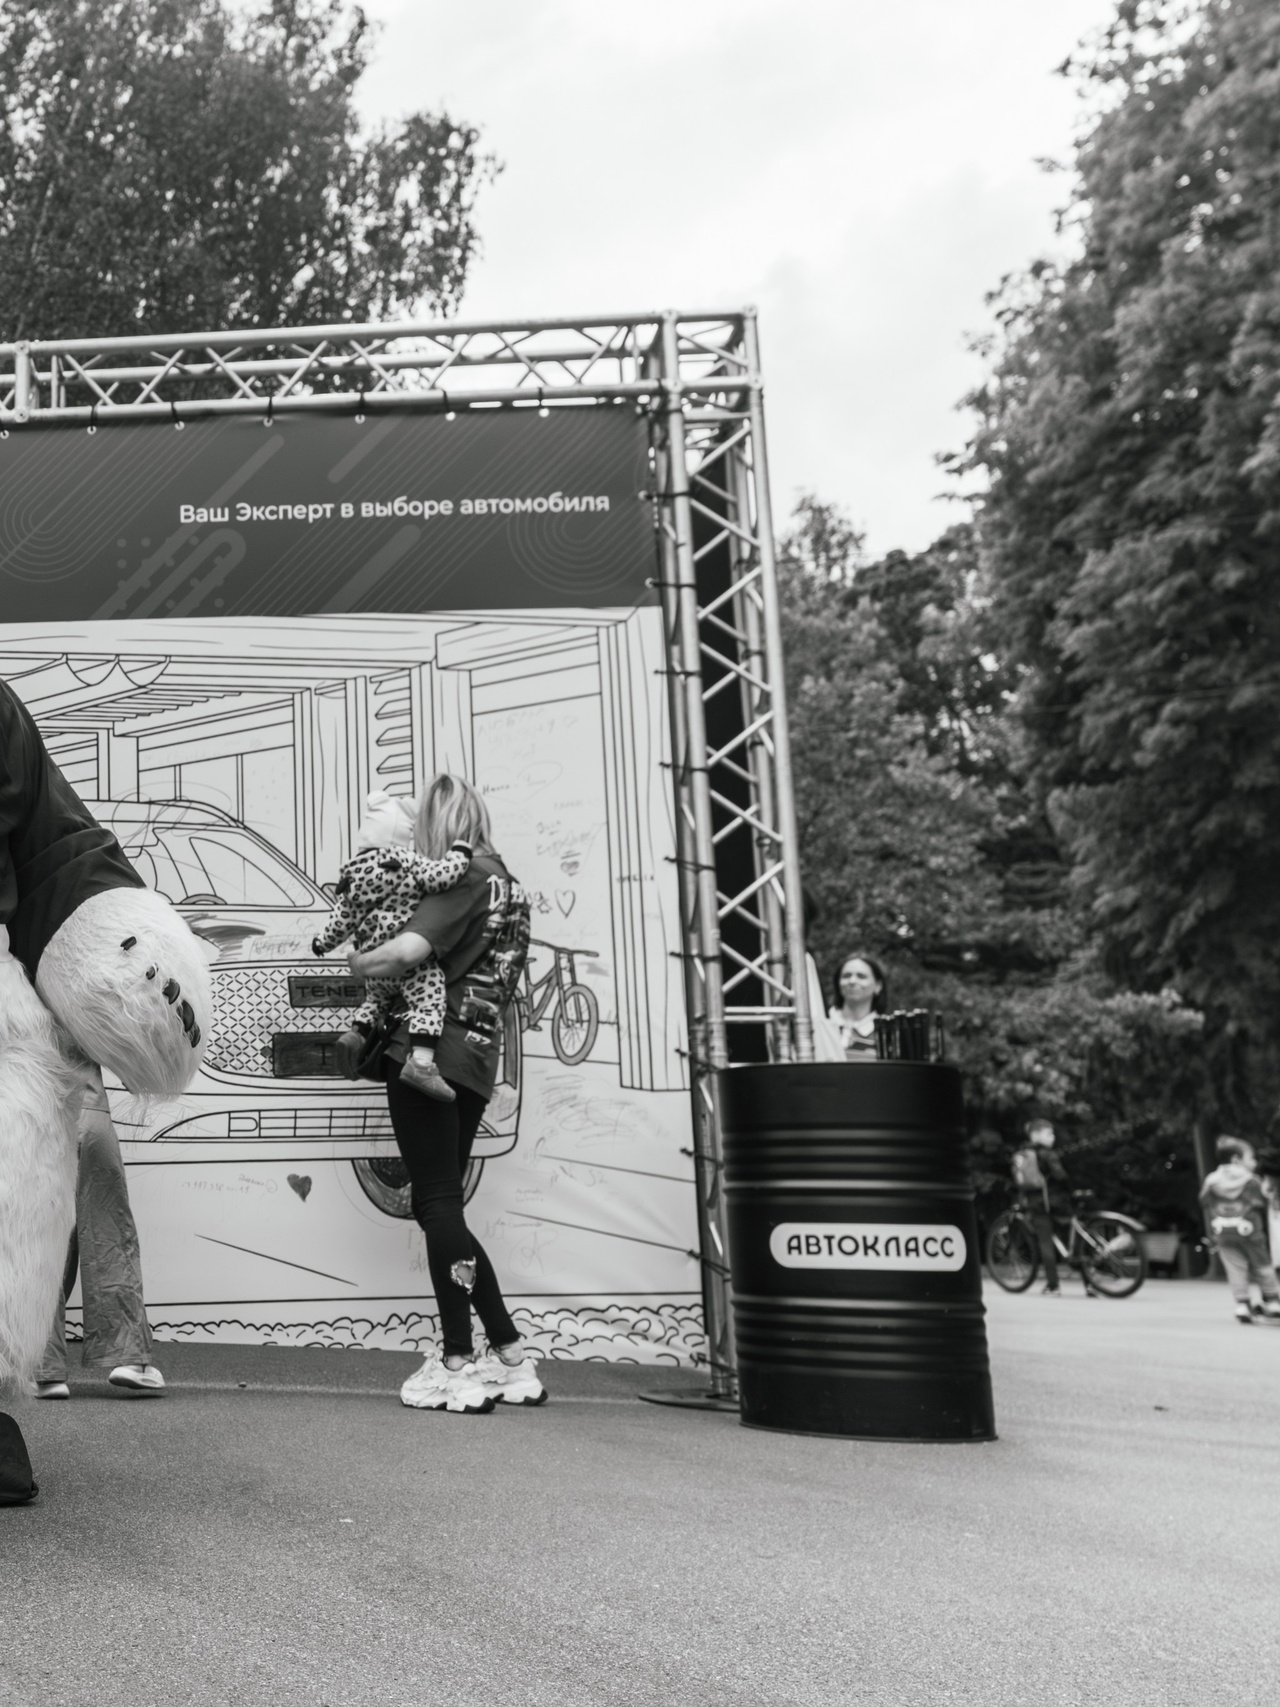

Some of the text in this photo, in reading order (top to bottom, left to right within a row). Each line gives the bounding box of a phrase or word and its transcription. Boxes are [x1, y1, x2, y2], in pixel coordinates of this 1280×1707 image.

[179, 491, 610, 524] Ваш Эксперт в выборе автомобиля
[786, 1234, 955, 1259] АВТОКЛАСС
